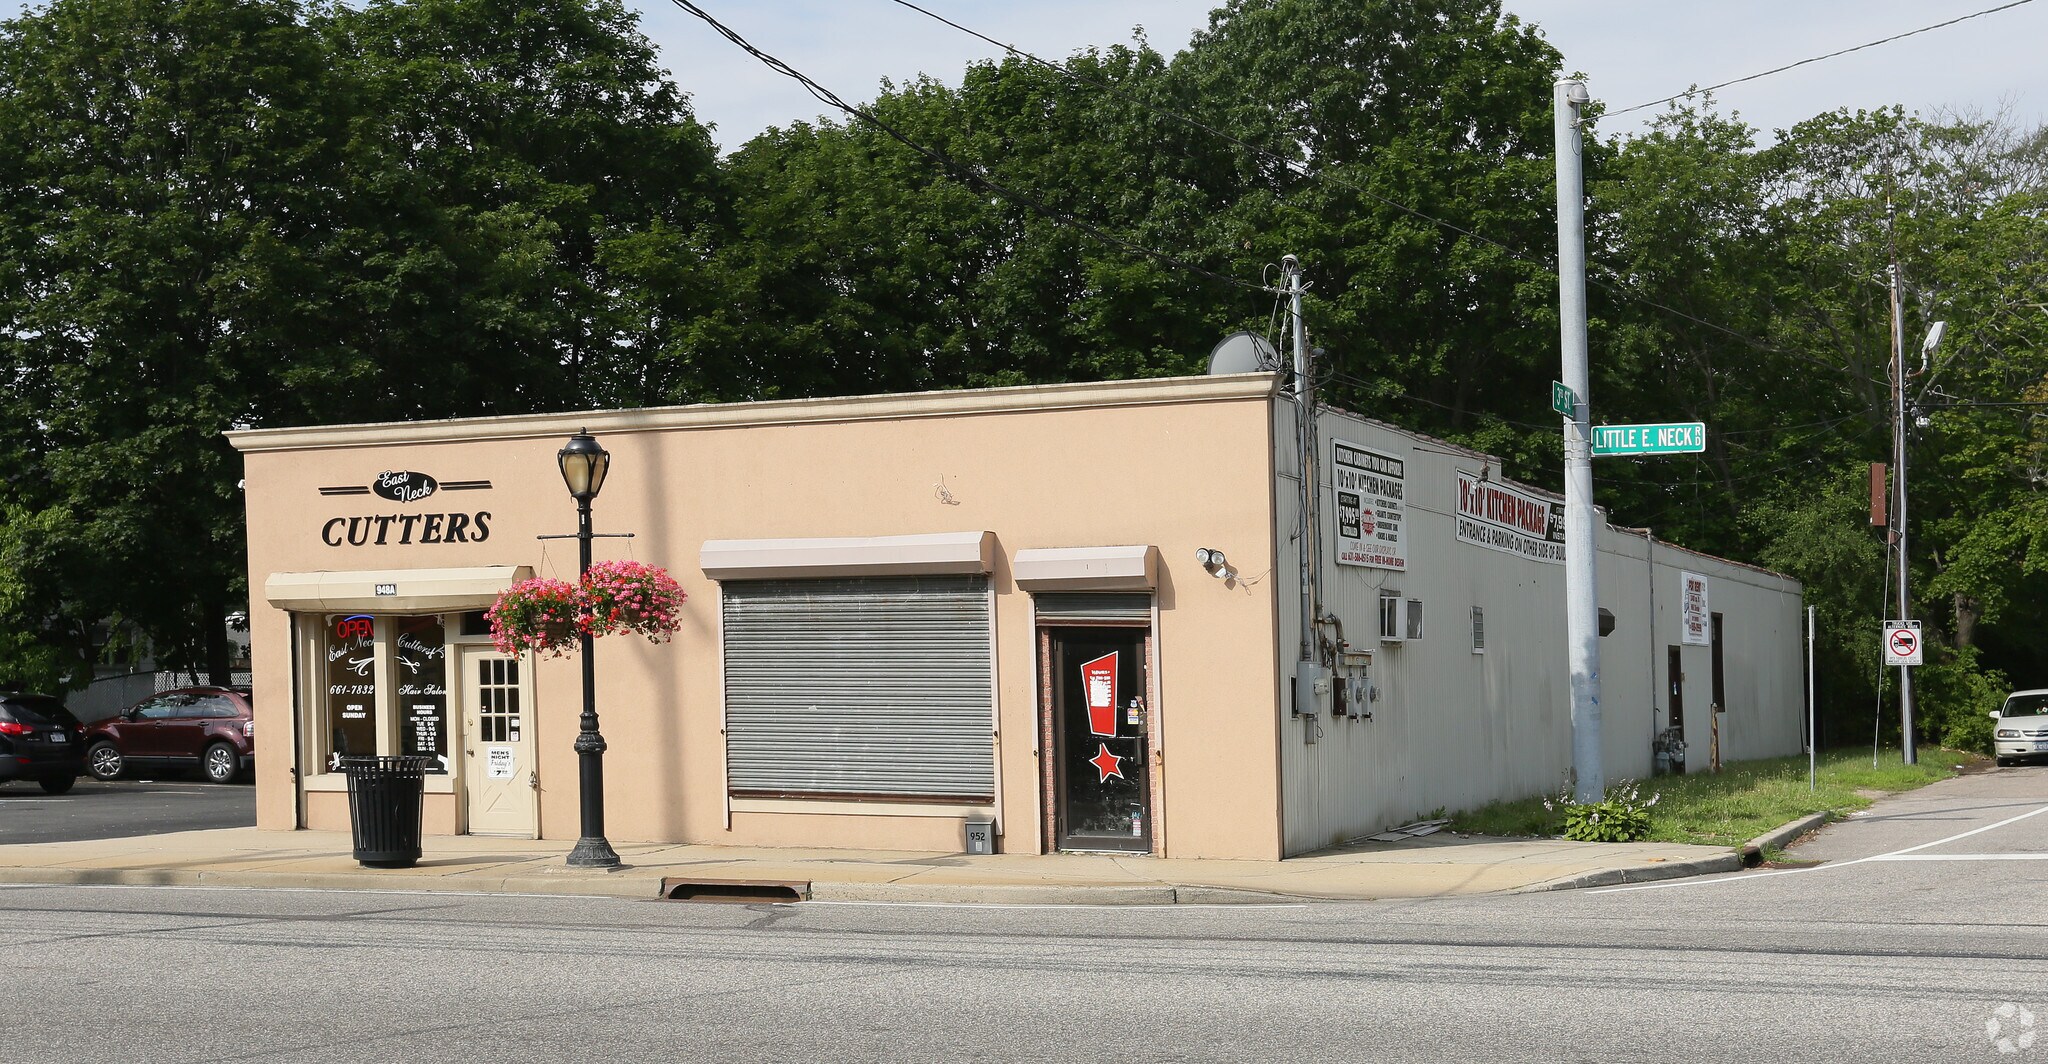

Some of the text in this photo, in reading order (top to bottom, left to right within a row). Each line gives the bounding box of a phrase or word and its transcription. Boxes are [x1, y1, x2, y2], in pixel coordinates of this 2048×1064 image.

[1564, 390, 1571, 410] ST
[1596, 426, 1701, 448] LITTLE E. NECK RD
[377, 470, 409, 488] East
[394, 479, 434, 502] Neck
[1486, 487, 1516, 527] KITCHEN
[1517, 497, 1545, 536] PACKAGE
[321, 511, 492, 547] CUTTERS
[1459, 519, 1486, 542] ENTRANCE
[1486, 529, 1491, 544] &
[1492, 530, 1514, 550] PARKING
[1515, 537, 1522, 553] ON
[1523, 538, 1538, 557] OTHER
[1538, 542, 1548, 558] SIDE
[1549, 544, 1555, 560] OF
[377, 585, 395, 595] 948A
[337, 620, 374, 638] OPEN
[328, 642, 348, 662] East
[397, 633, 431, 656] Cutters
[330, 685, 374, 695] 661-7832
[398, 684, 446, 695] Hair Salon
[970, 832, 985, 841] 952
